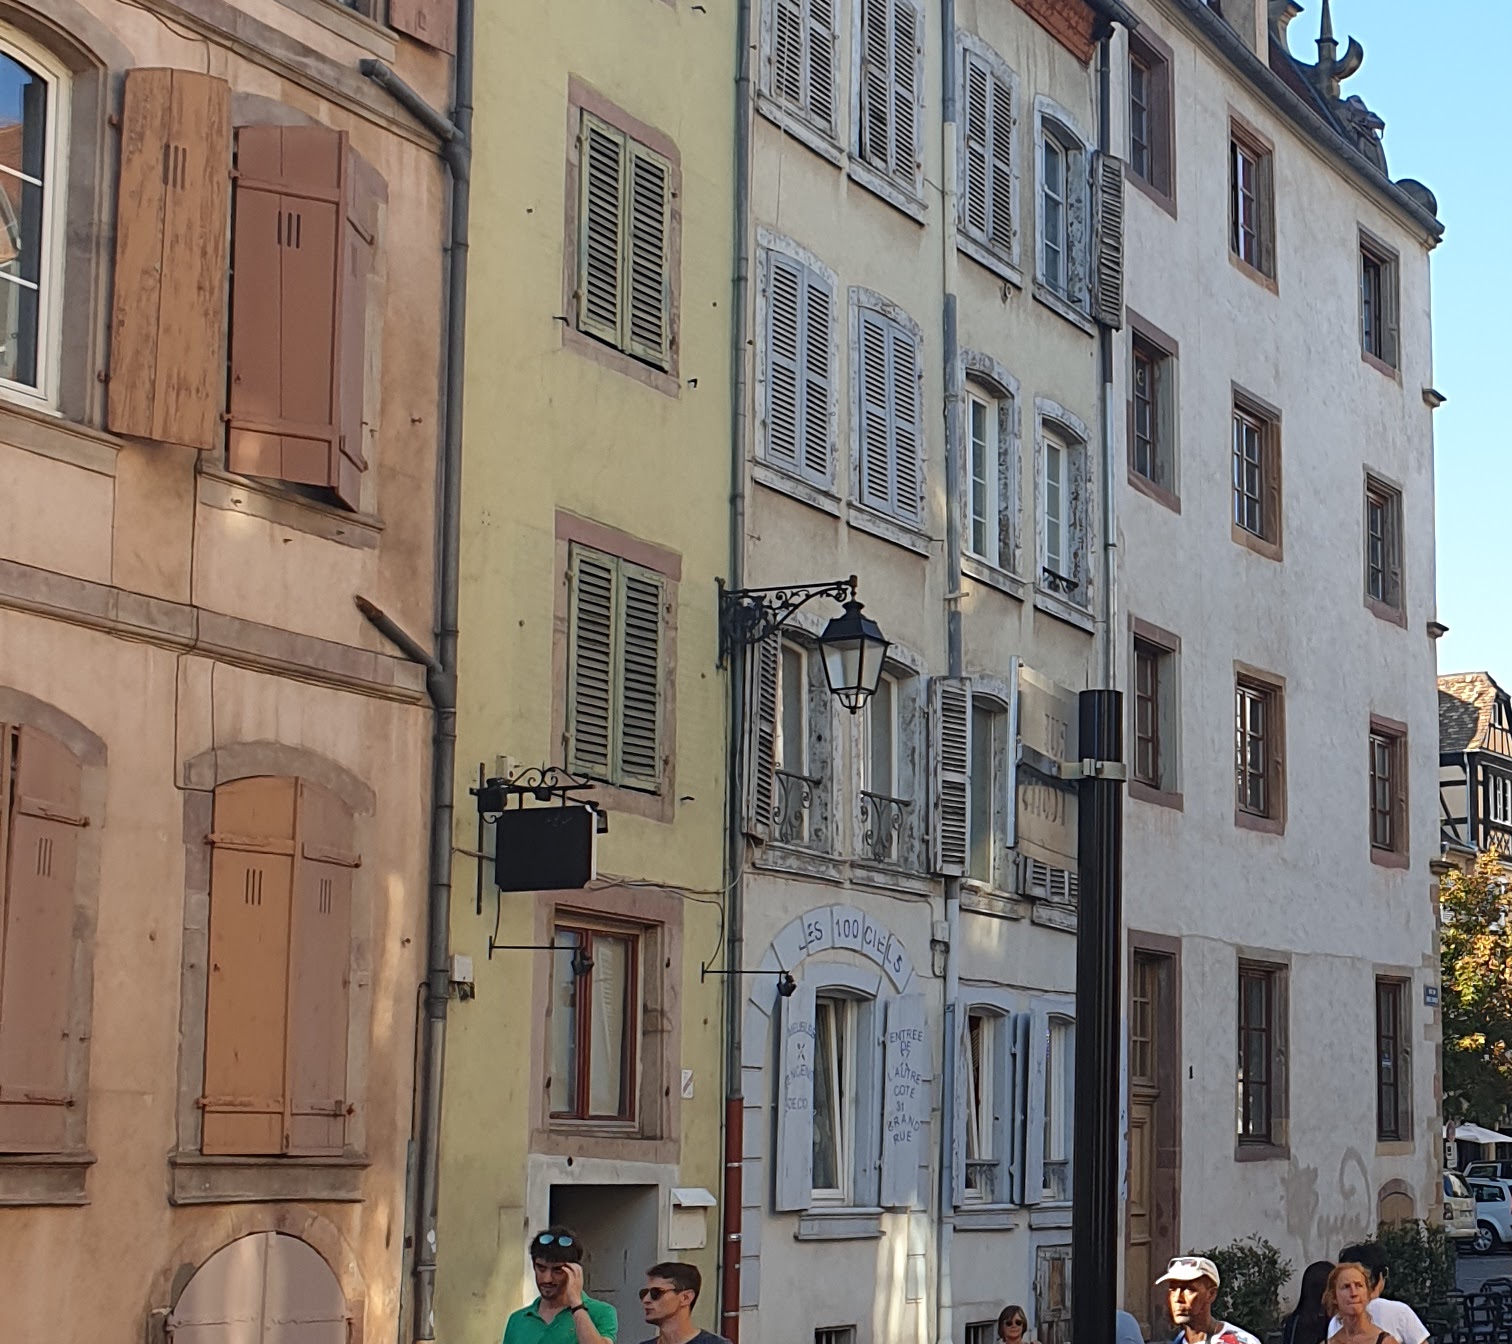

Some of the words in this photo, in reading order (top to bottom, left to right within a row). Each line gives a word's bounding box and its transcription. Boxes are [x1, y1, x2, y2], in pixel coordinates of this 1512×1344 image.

[835, 919, 859, 939] 100
[864, 925, 903, 973] CIELS
[887, 1113, 921, 1133] GRAND
[893, 1130, 912, 1147] RUE
